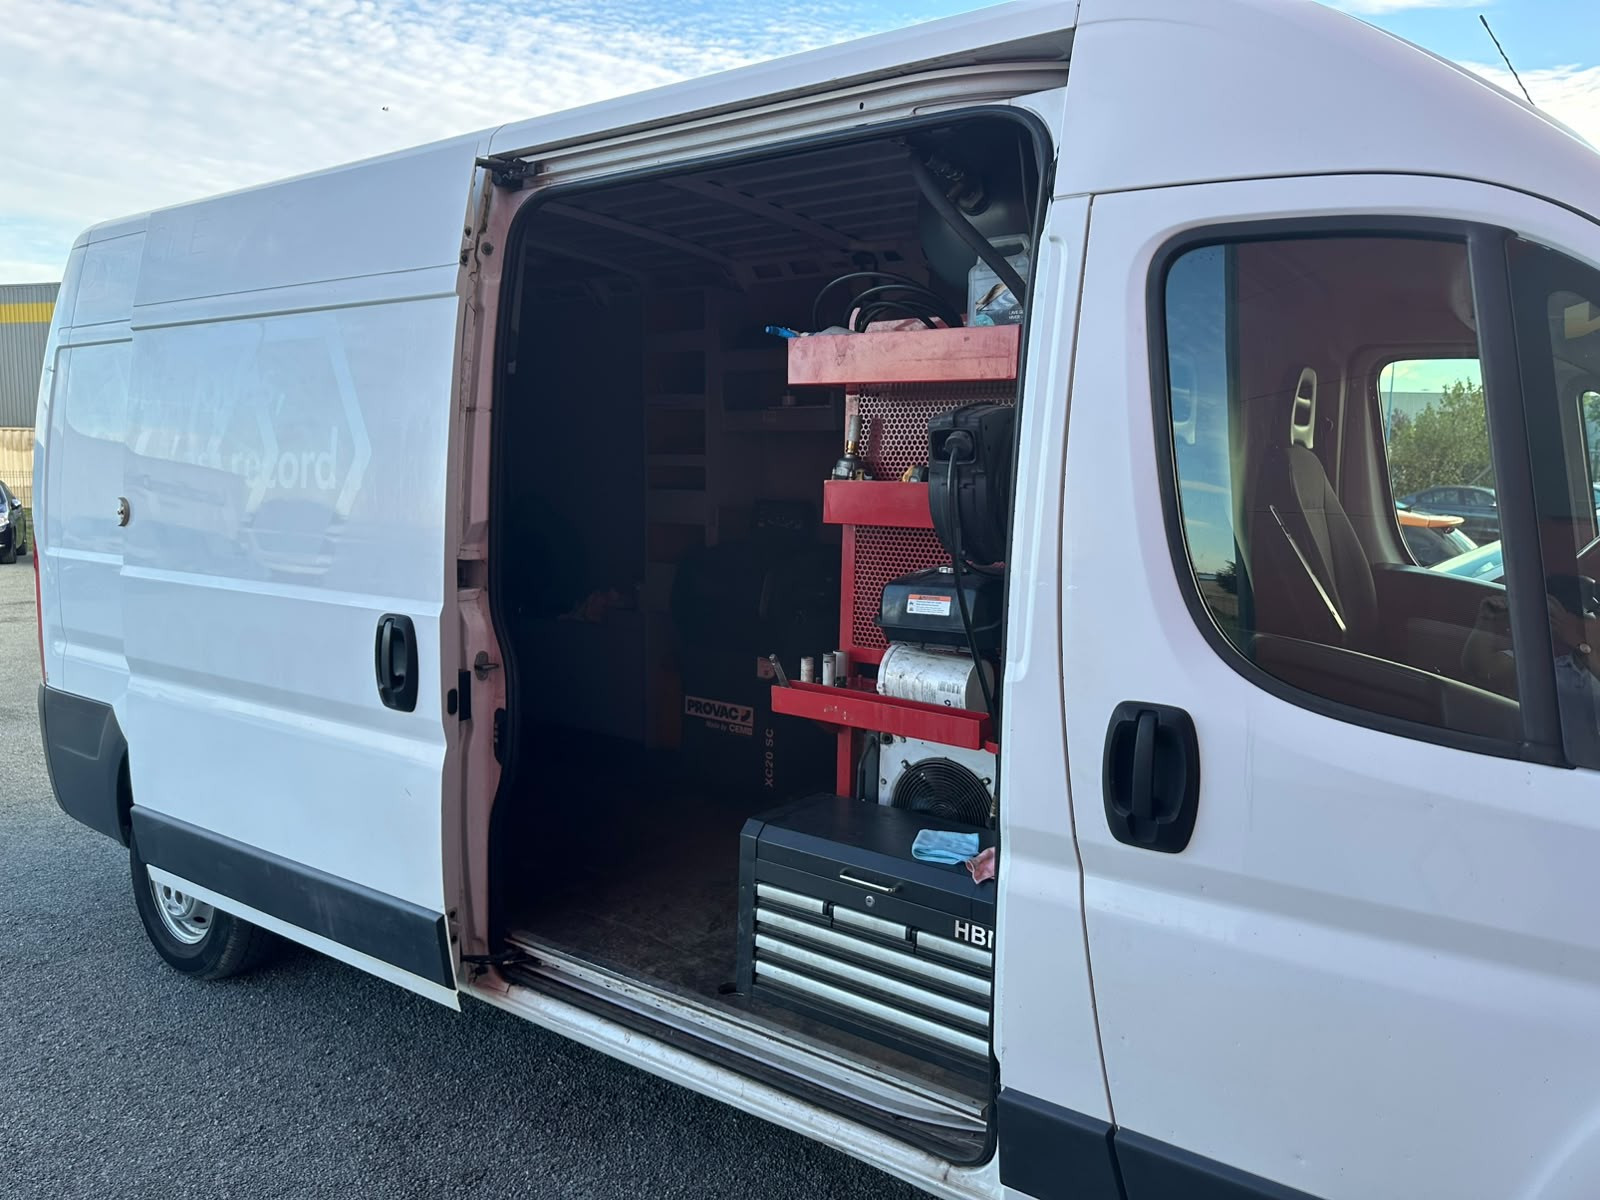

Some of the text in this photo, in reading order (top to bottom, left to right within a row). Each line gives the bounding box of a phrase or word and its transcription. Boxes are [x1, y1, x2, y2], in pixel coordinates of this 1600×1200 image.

[687, 699, 739, 720] PROVAC
[765, 728, 774, 788] XC20 SC
